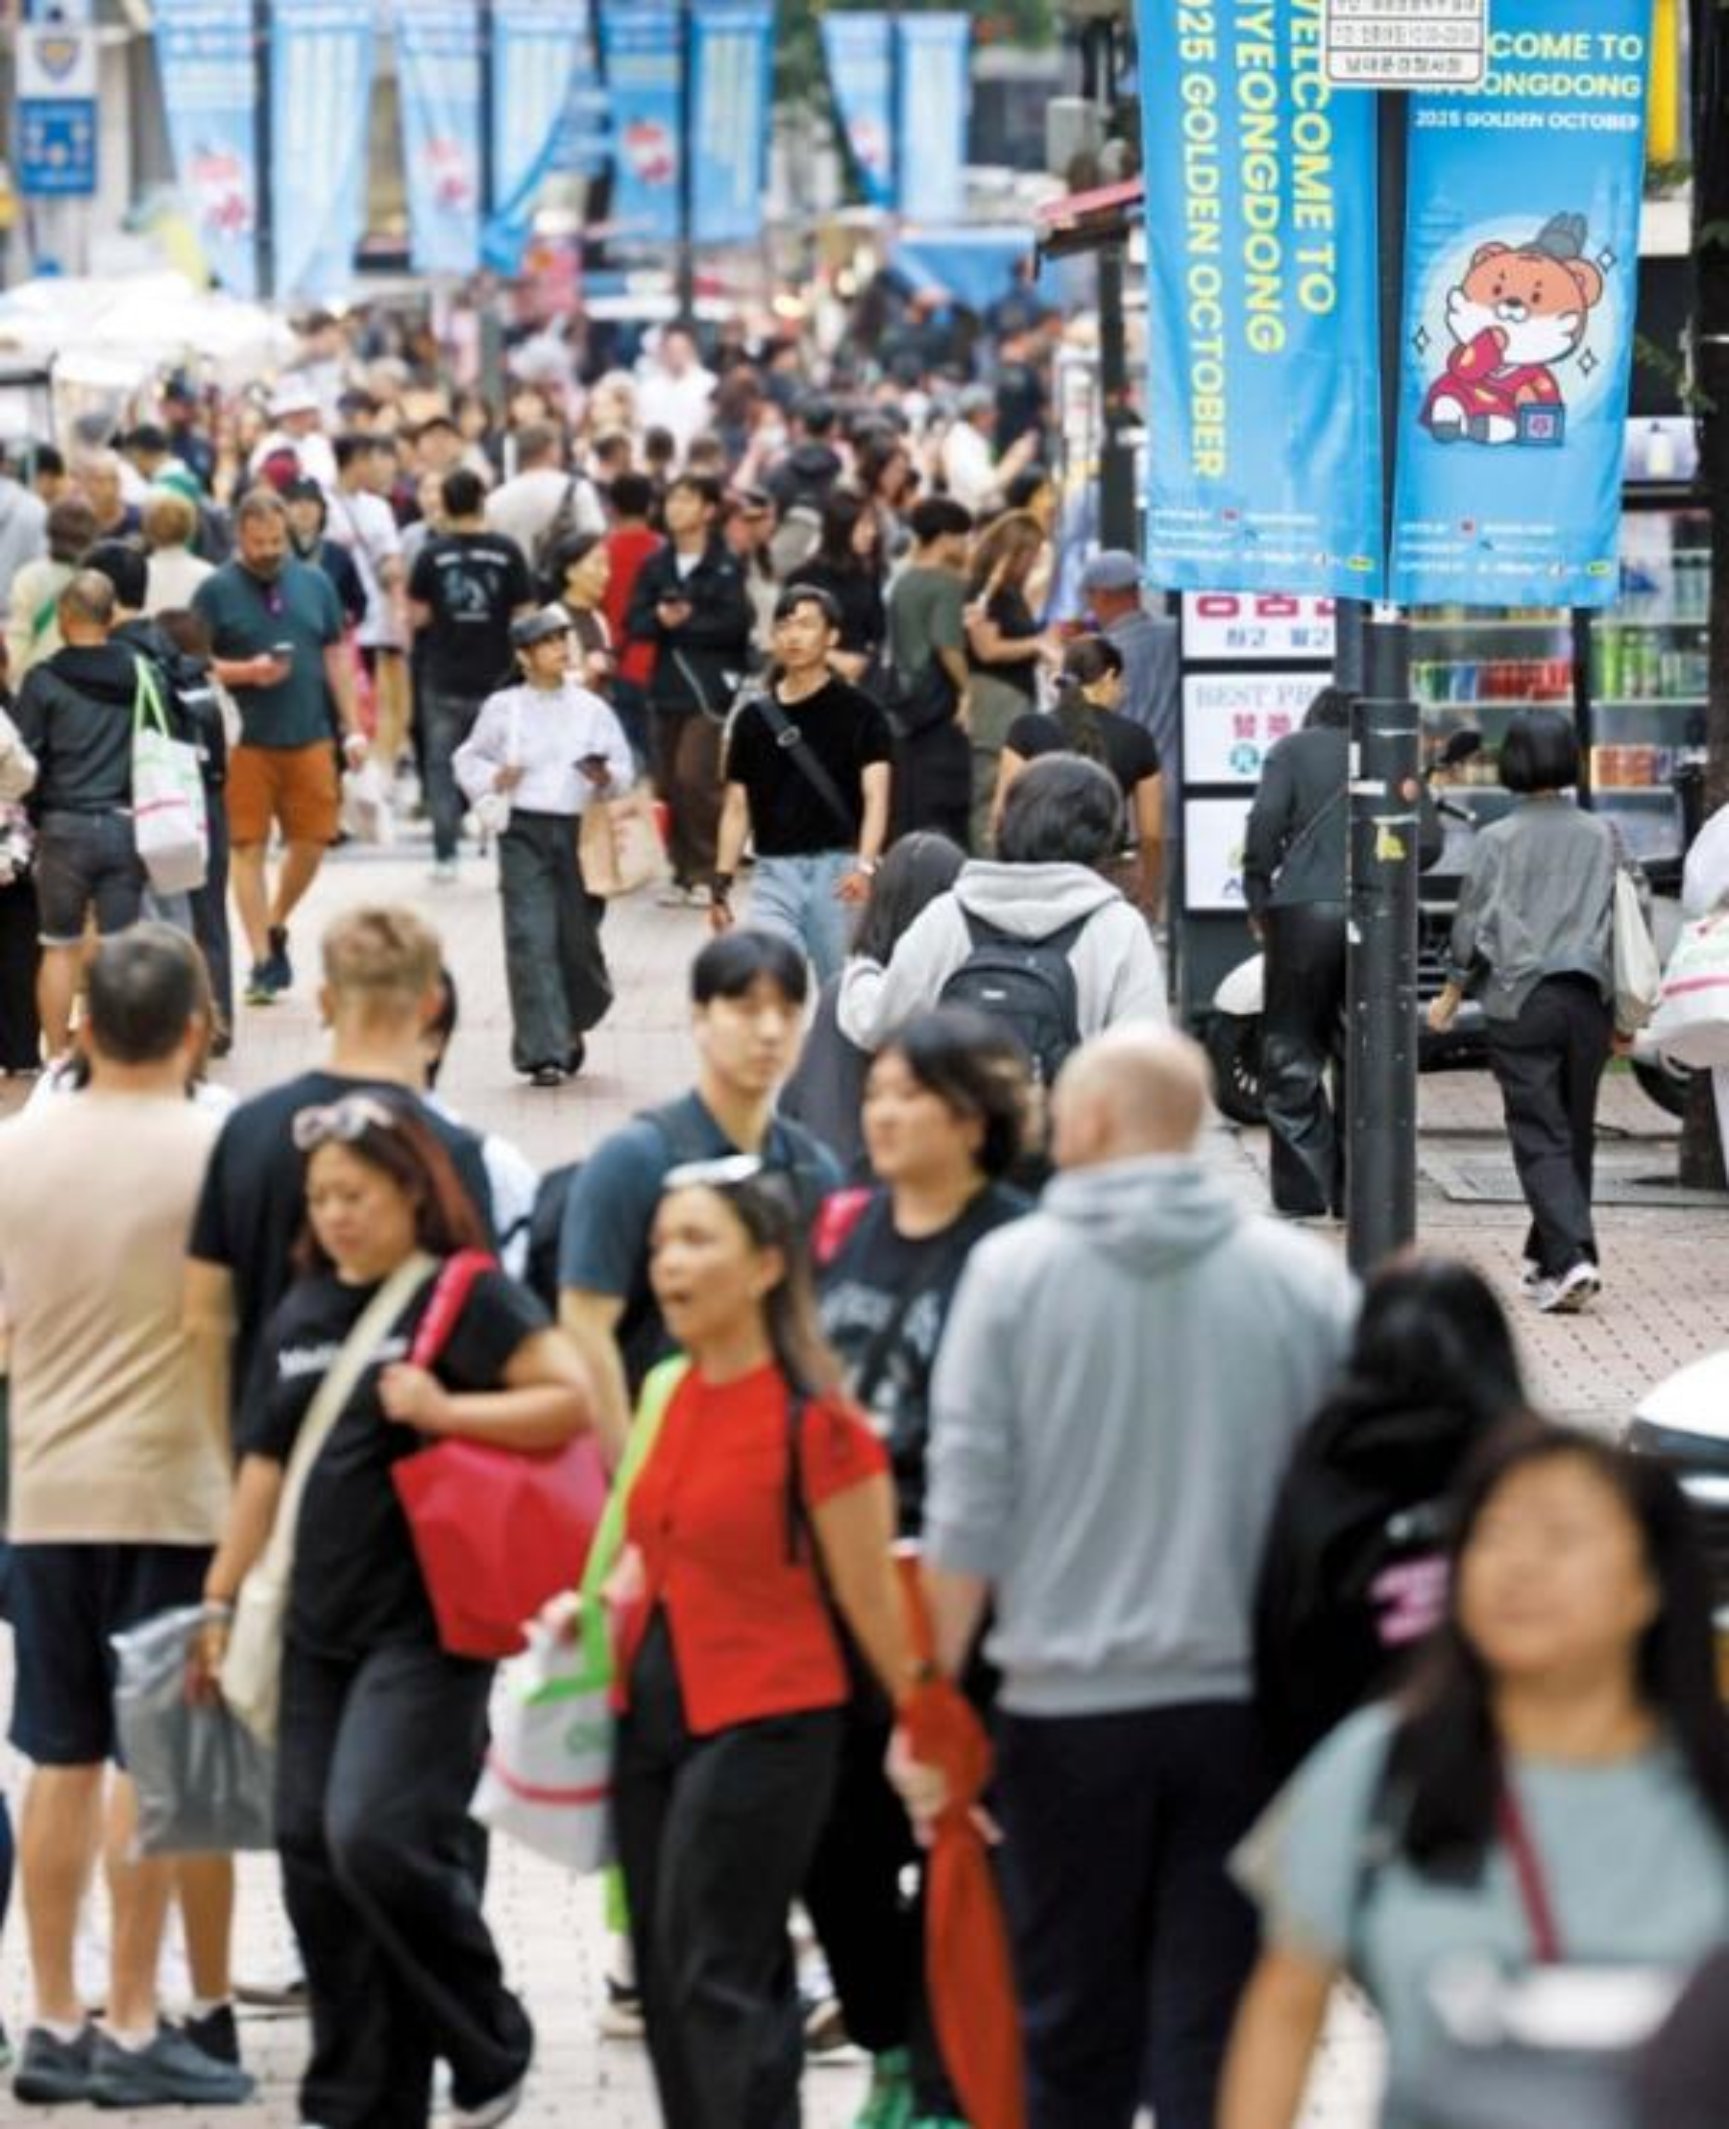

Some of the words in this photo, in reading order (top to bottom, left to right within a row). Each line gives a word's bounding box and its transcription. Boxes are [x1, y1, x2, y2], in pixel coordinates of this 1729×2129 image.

[1178, 0, 1216, 62] 25
[1489, 31, 1592, 61] COME
[1598, 33, 1644, 62] TO
[1418, 70, 1643, 99] ONGDONG
[1465, 110, 1544, 130] GOLDEN
[1548, 112, 1640, 132] OCTOBER
[1180, 74, 1221, 254] GOLDEN
[1235, 0, 1286, 352] YEONGDONG
[1296, 241, 1336, 314] TO
[1187, 264, 1226, 477] OCTOBER
